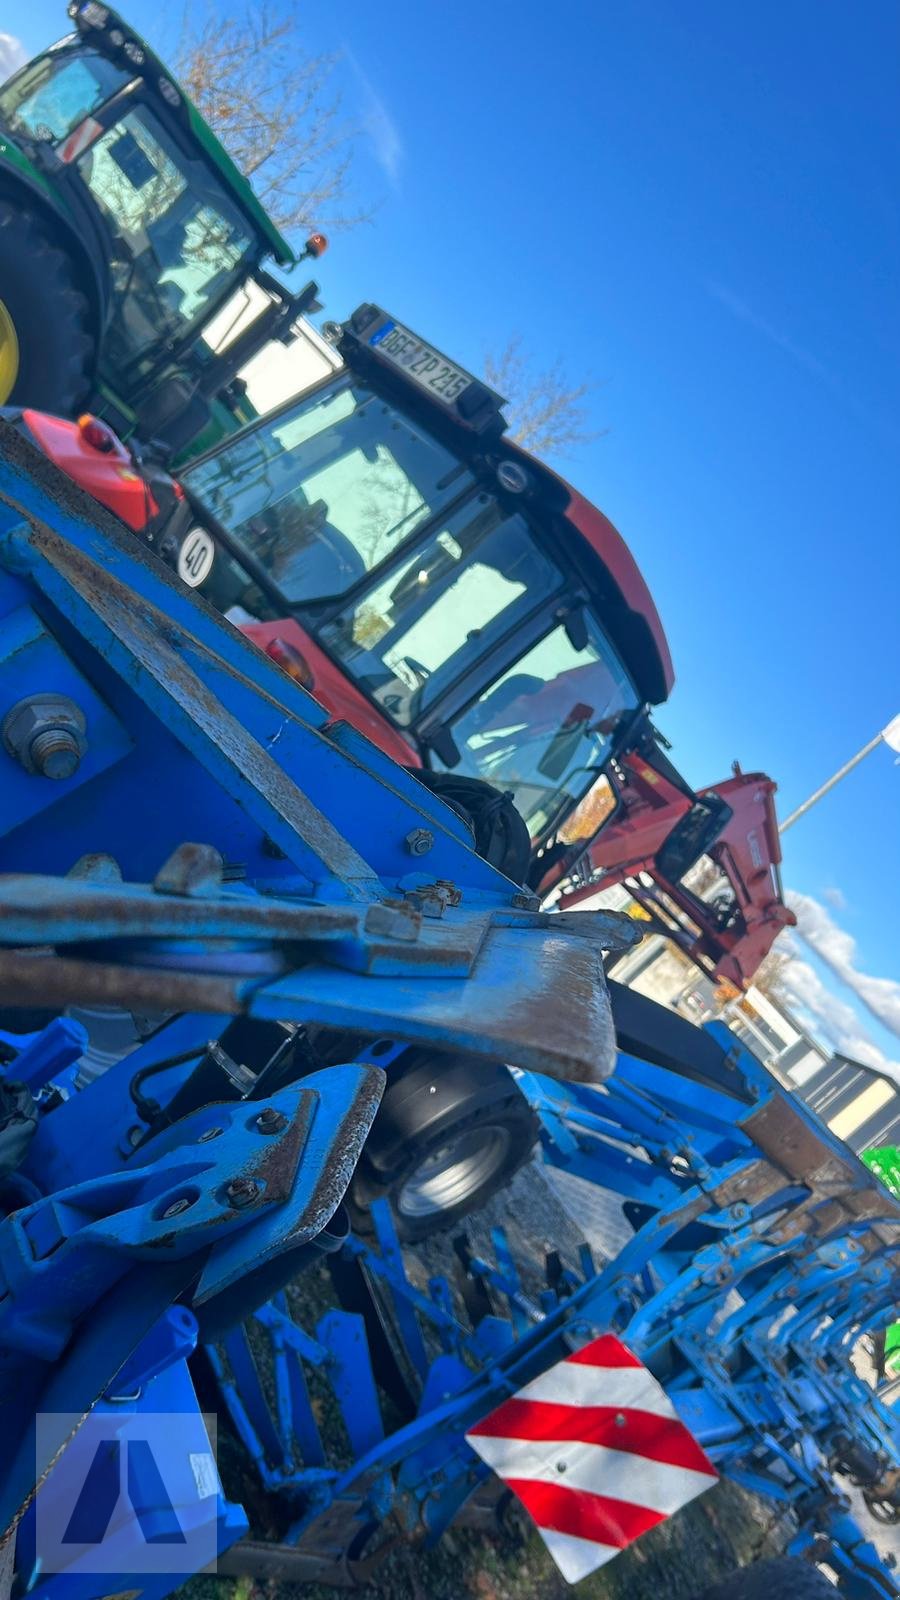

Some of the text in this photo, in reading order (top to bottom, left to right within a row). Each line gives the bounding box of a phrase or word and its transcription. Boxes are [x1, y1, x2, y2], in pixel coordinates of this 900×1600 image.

[408, 352, 439, 377] ZP
[428, 366, 471, 399] 215
[185, 538, 208, 577] 40
